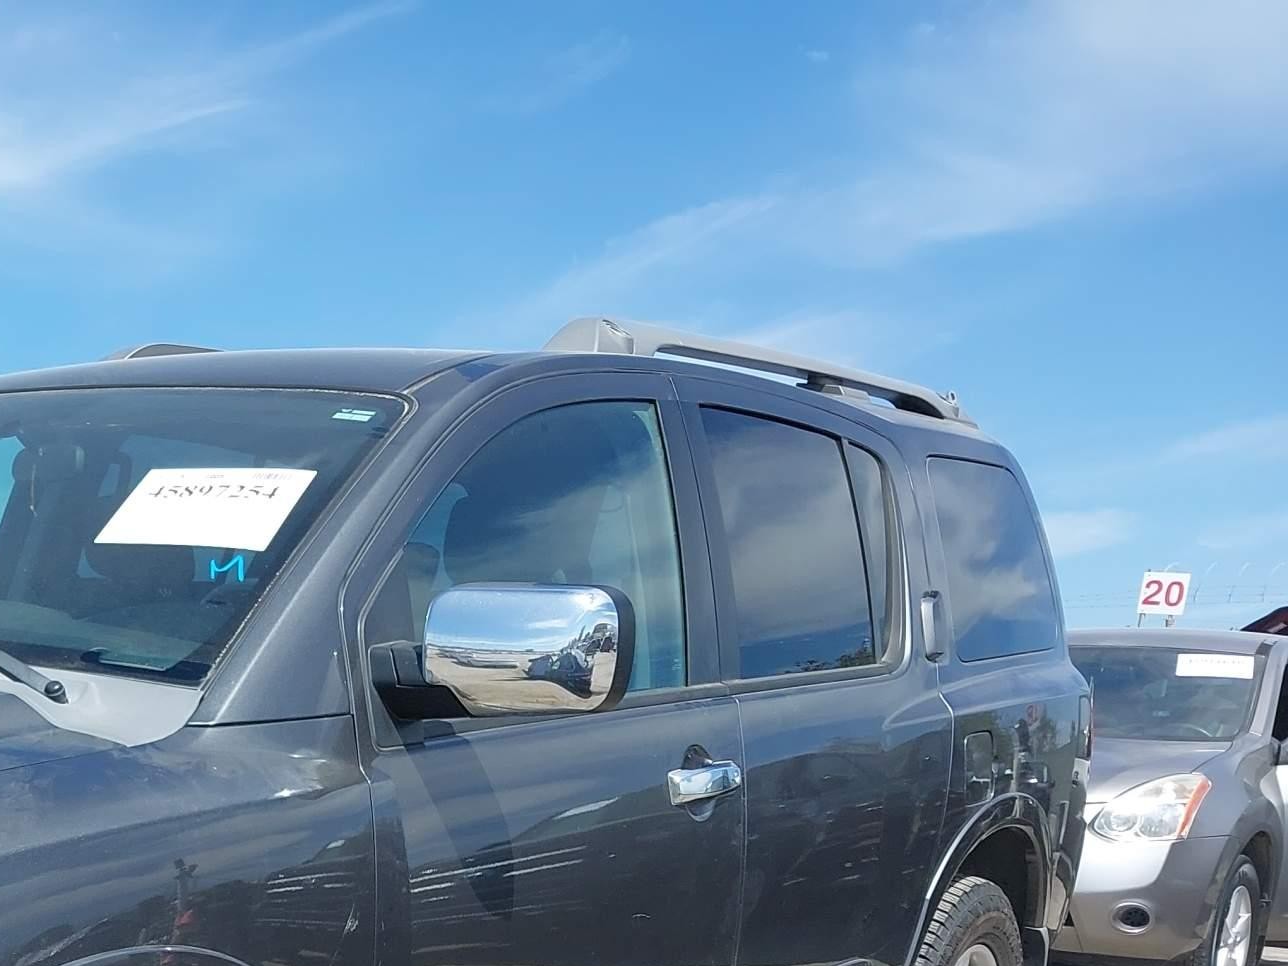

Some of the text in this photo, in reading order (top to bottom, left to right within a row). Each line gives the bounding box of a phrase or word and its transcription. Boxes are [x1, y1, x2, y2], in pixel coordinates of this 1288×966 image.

[148, 484, 279, 499] 45897254
[208, 554, 245, 583] M
[1141, 579, 1185, 607] 20
